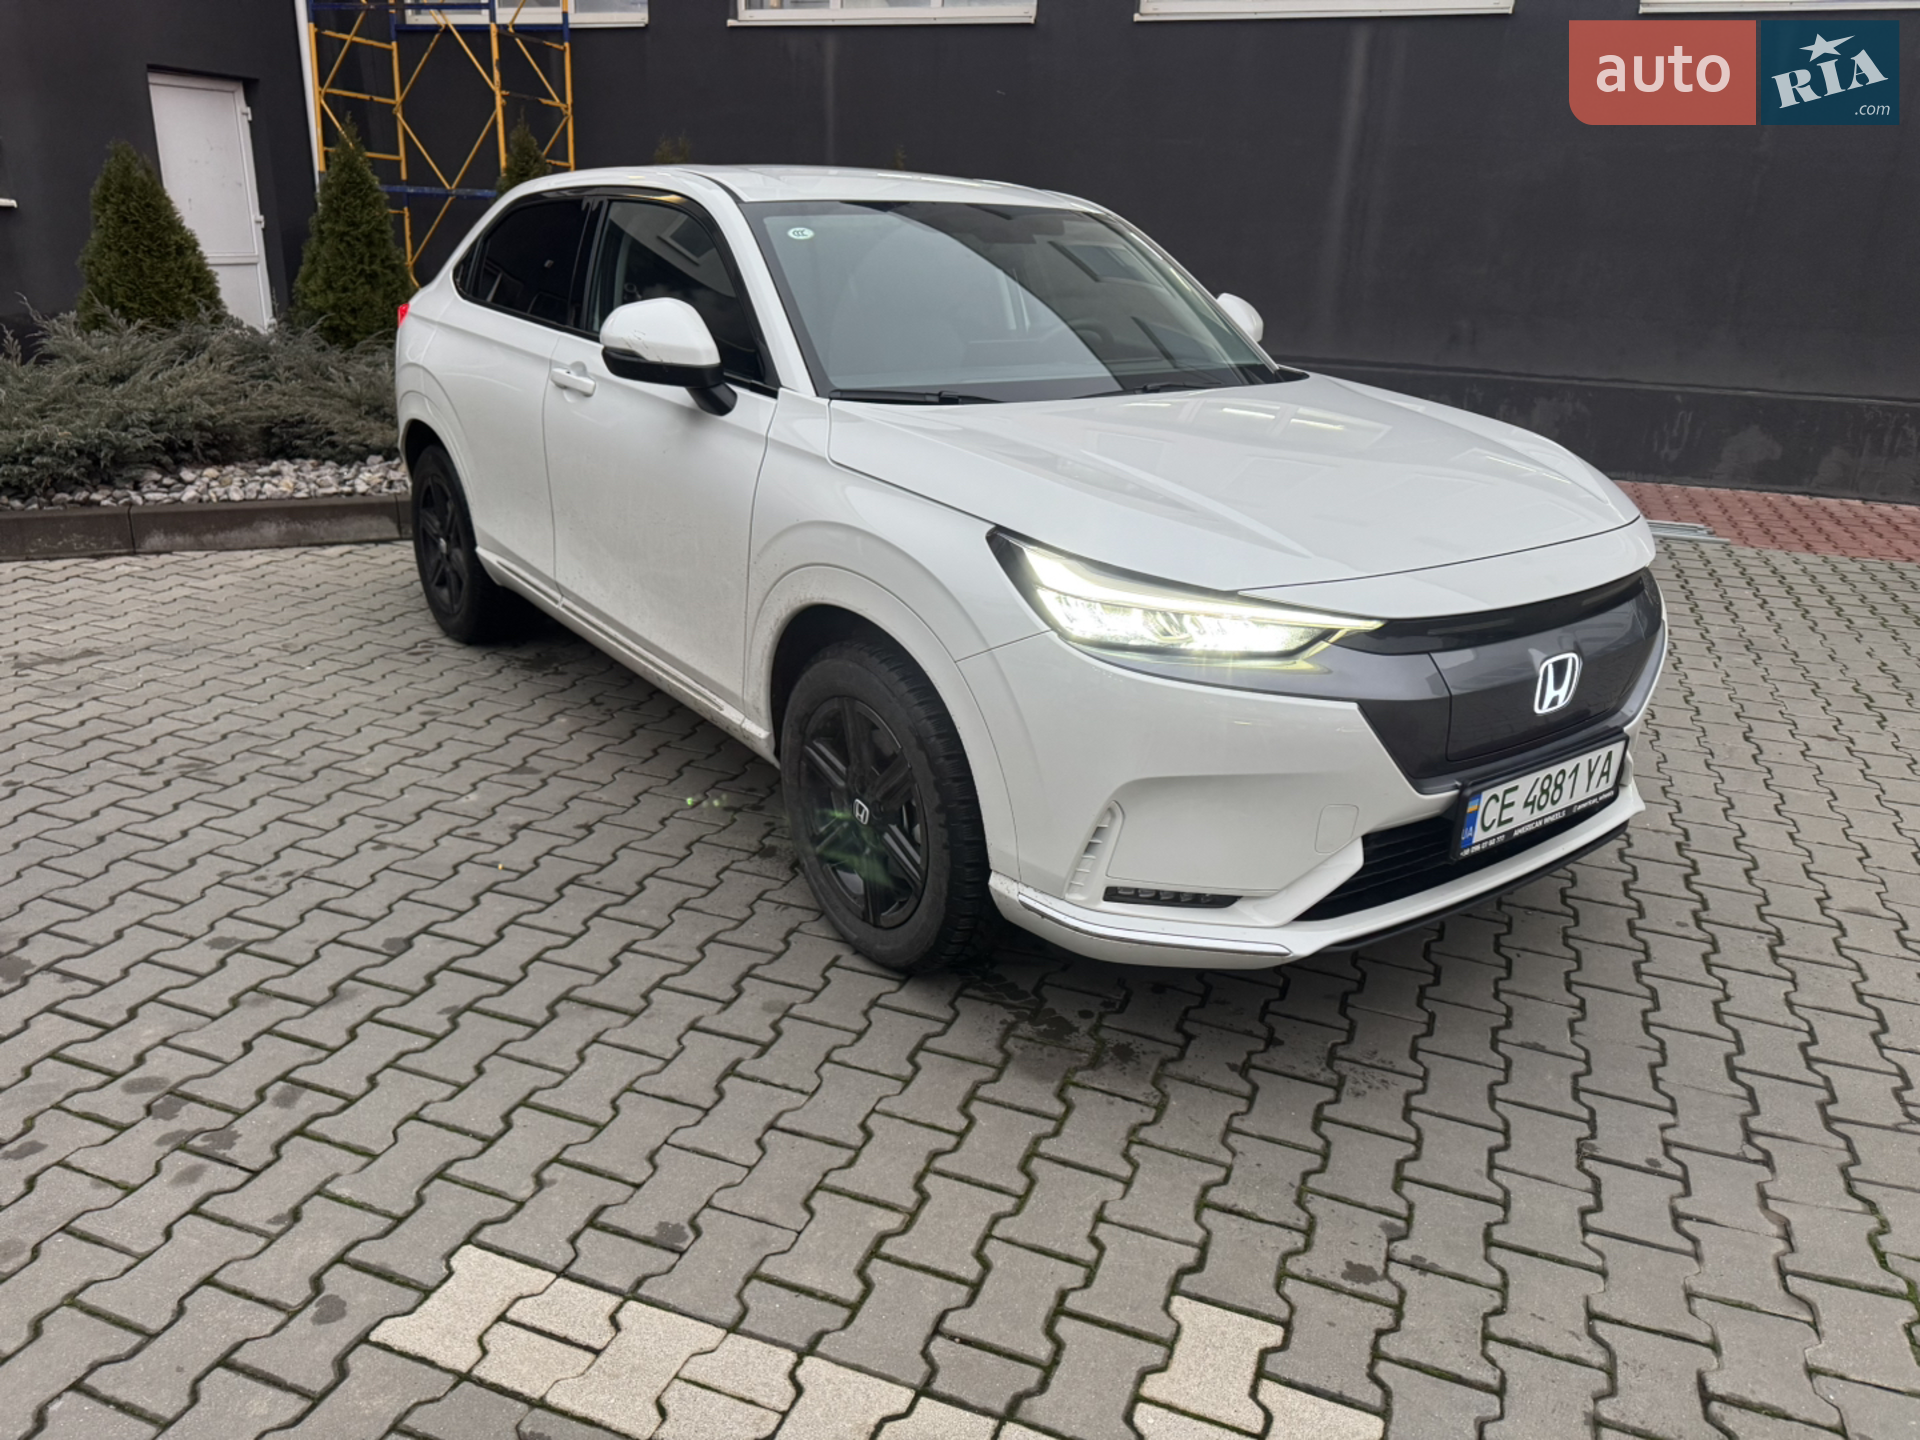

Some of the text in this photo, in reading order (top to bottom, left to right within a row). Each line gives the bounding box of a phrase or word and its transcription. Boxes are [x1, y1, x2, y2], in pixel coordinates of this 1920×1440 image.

[1480, 750, 1613, 832] CE 4881 YA
[1461, 826, 1473, 840] UA
[1513, 819, 1543, 837] AMERICAN
[1543, 810, 1566, 825] WHEELS
